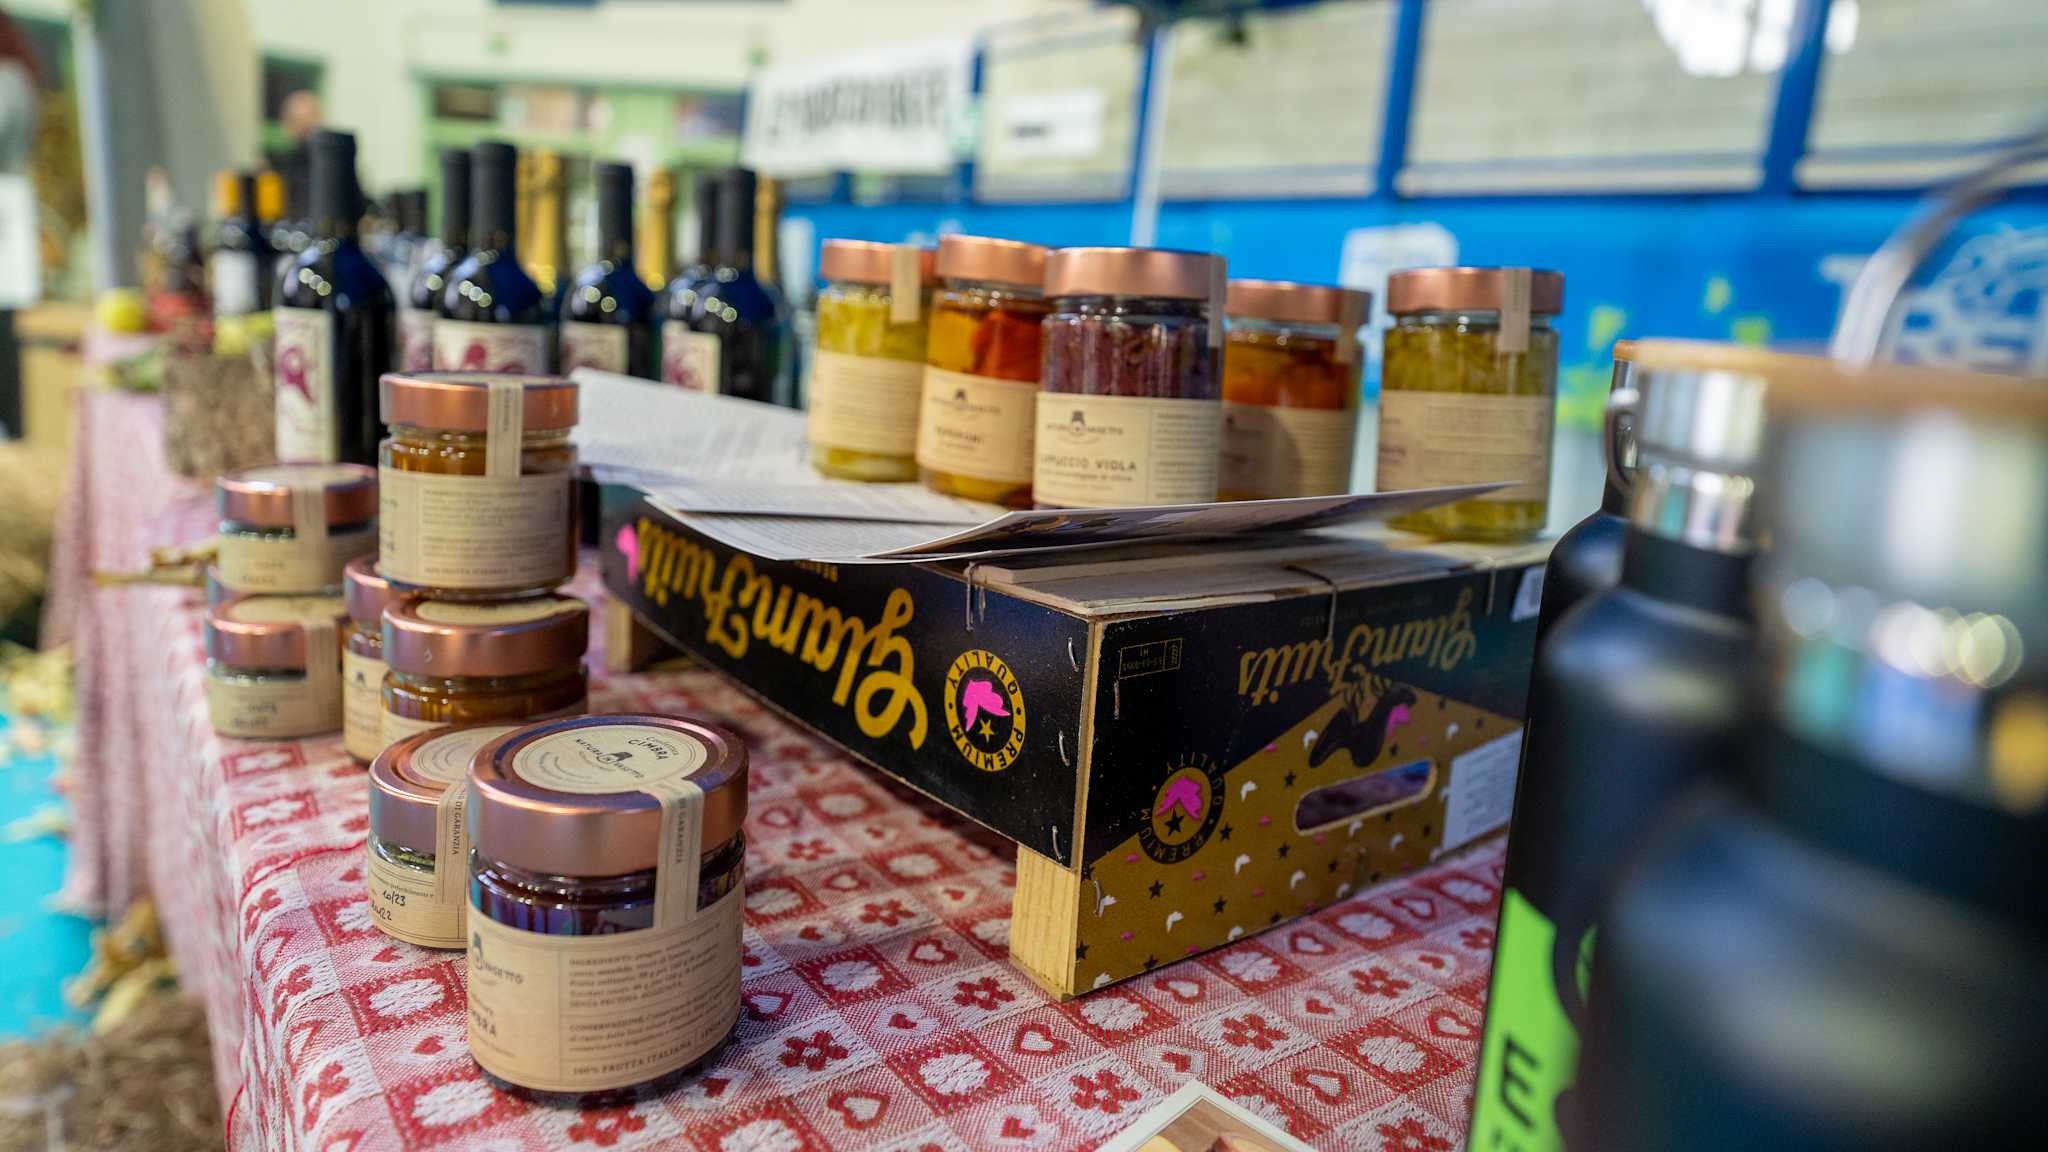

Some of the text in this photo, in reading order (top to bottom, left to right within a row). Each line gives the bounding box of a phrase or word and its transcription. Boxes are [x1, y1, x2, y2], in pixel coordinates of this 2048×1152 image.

[1095, 458, 1136, 472] VIOLA
[945, 650, 1018, 696] QUALITY
[627, 738, 669, 760] CIMBRA
[950, 723, 1024, 771] PREMIUM
[451, 812, 463, 855] GARANZIA
[601, 1057, 644, 1072] FRUTTA
[646, 1039, 692, 1063] ITALIANA
